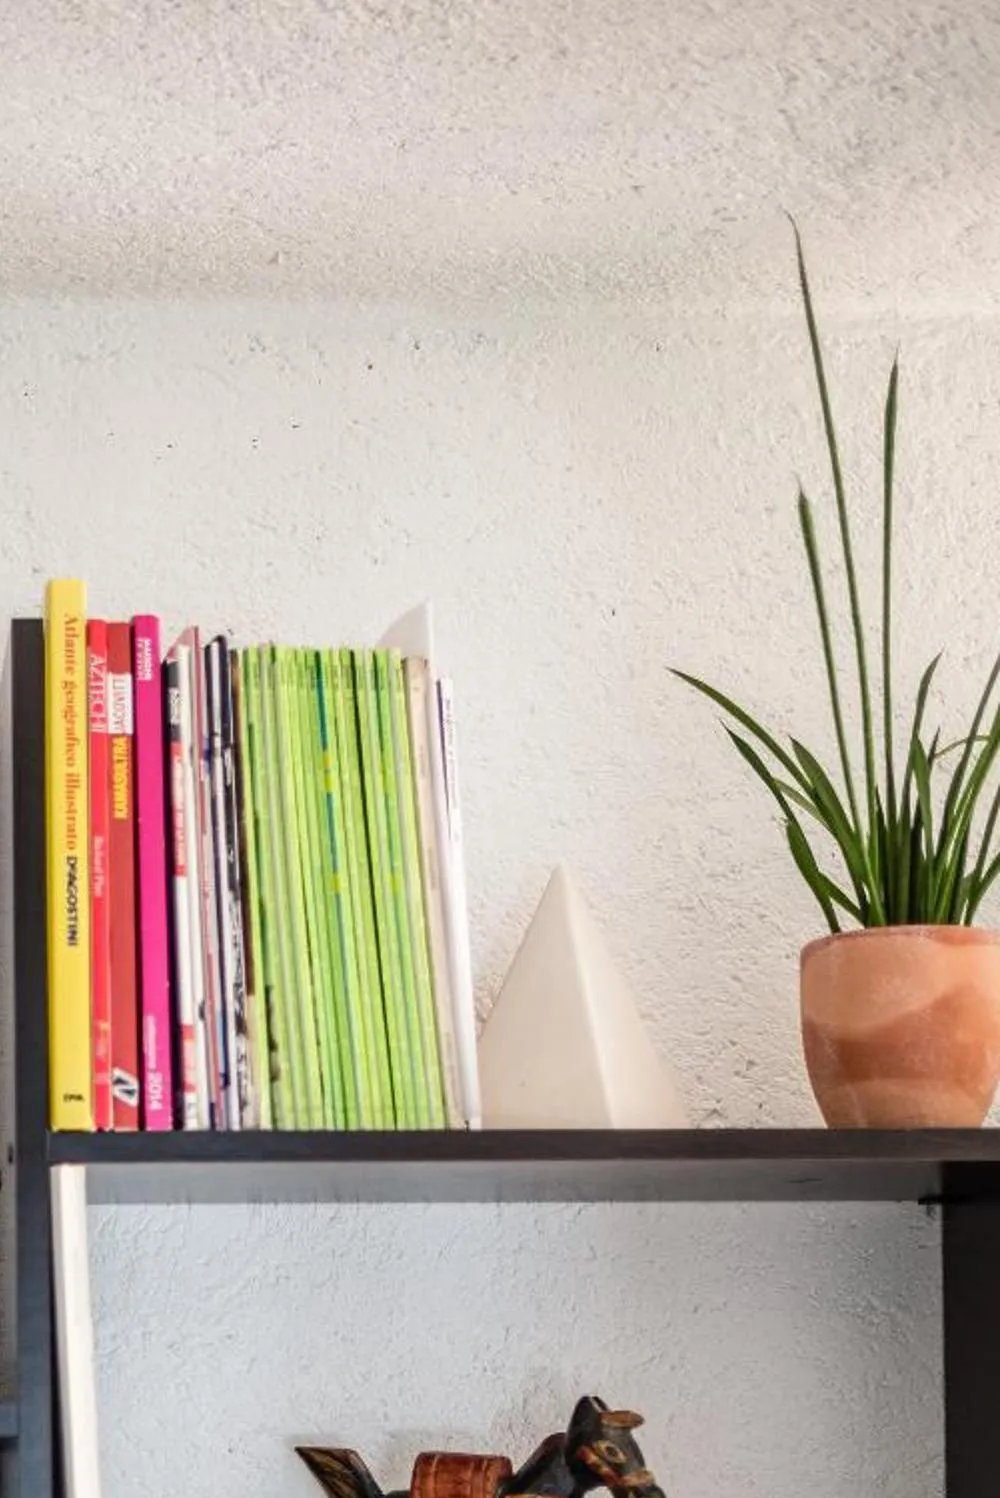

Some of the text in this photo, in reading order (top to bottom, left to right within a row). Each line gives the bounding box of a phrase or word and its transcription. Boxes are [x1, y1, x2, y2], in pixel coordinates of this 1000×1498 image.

[63, 613, 80, 850] Atlante geografico illustrato
[88, 653, 107, 733] AZTECHI
